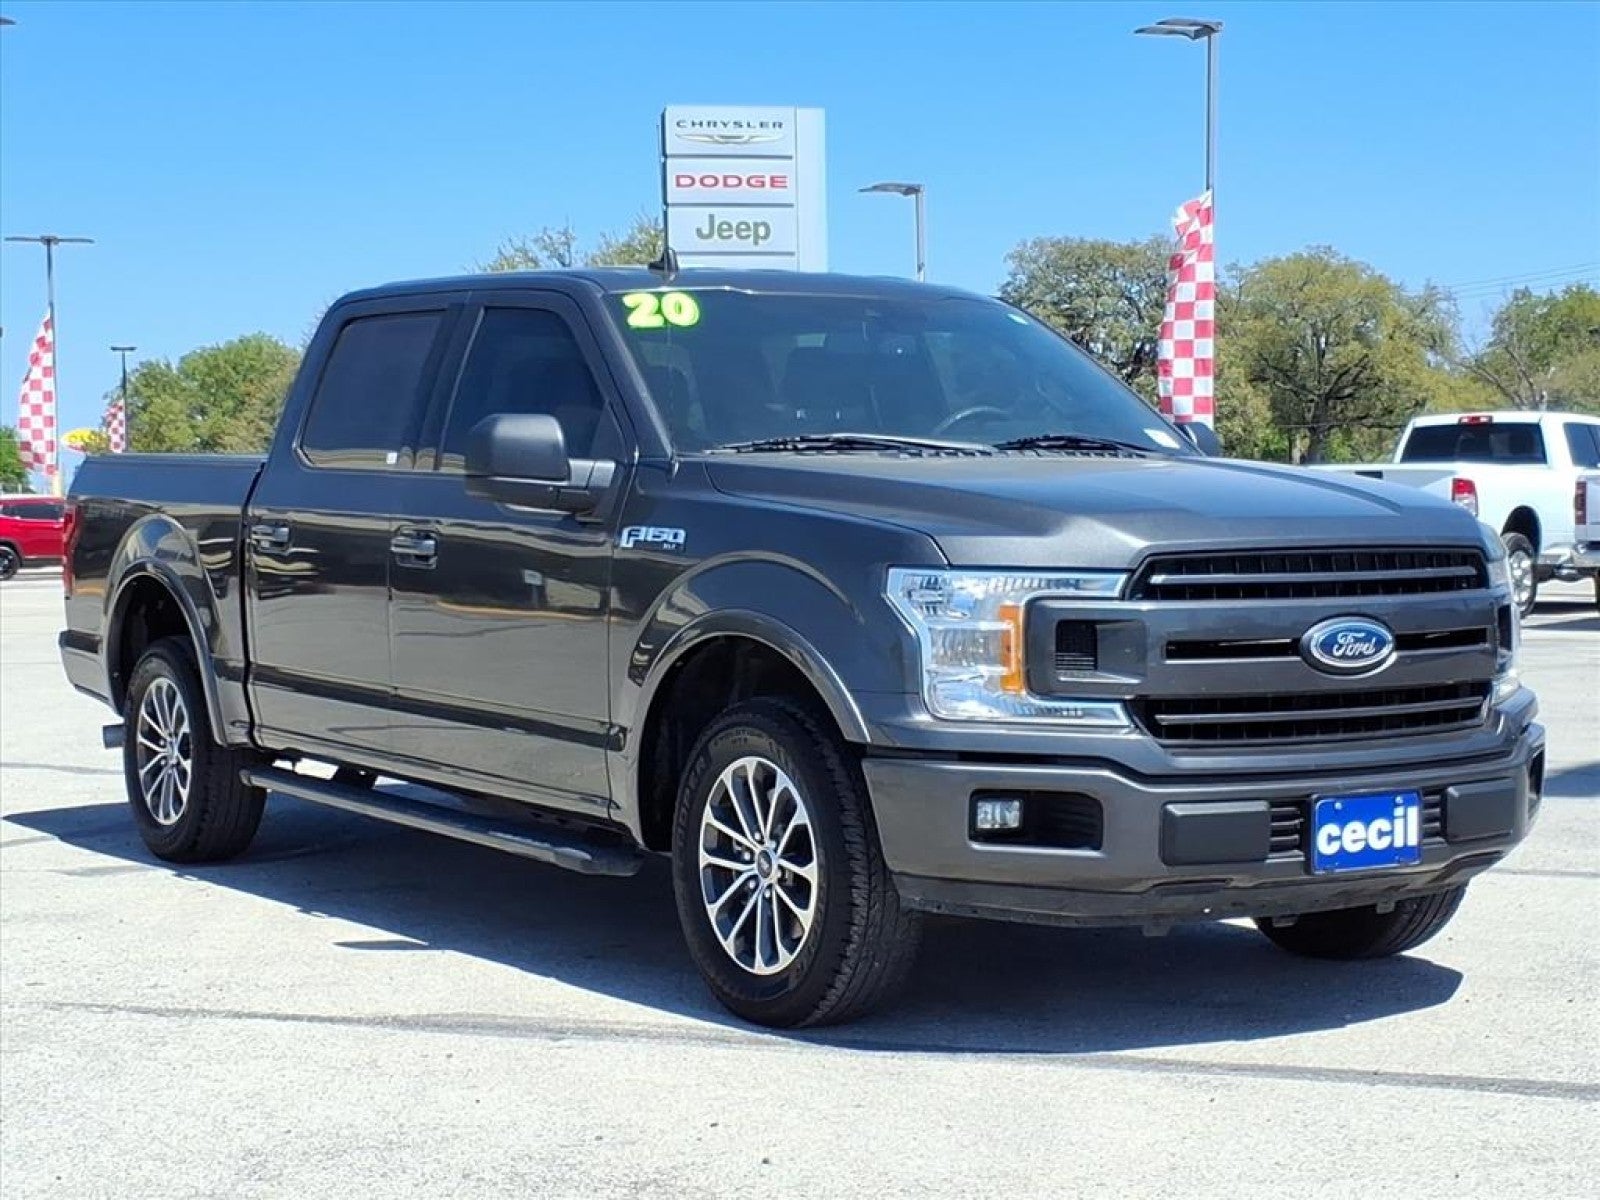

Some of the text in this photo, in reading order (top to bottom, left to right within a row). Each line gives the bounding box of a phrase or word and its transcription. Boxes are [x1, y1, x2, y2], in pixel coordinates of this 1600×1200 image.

[675, 119, 784, 129] CHRYSLER
[675, 175, 788, 189] DODGE
[696, 214, 771, 245] Jeep
[622, 292, 700, 328] 20
[1332, 632, 1376, 656] Ford
[1316, 805, 1418, 855] cecil
